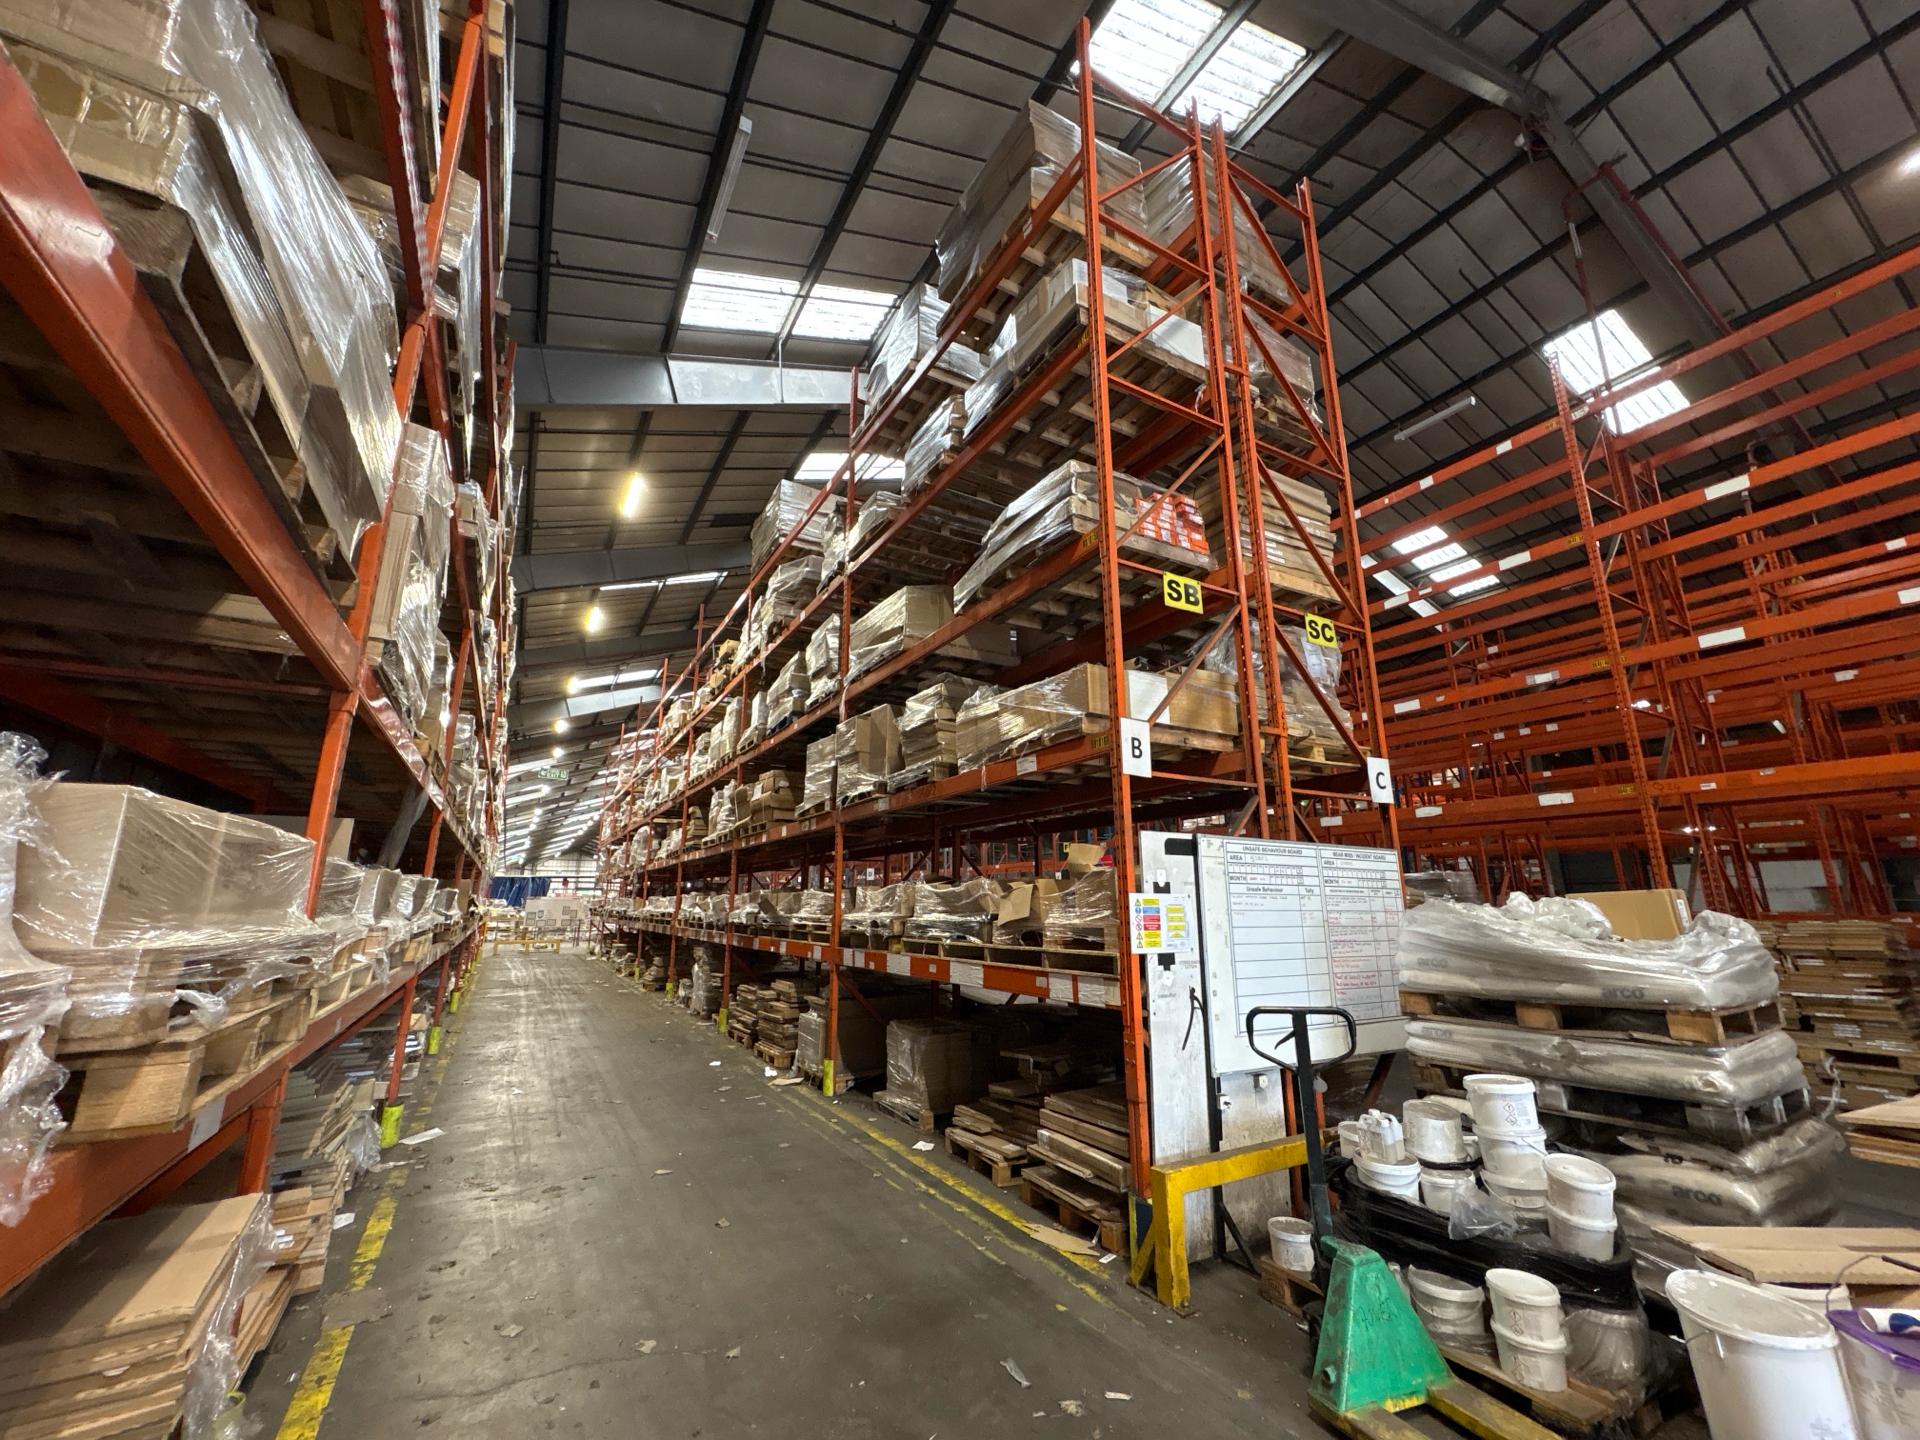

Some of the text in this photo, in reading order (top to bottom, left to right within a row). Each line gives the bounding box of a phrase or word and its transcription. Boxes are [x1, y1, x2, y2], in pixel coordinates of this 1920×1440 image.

[1167, 579, 1200, 607] SB
[1308, 619, 1335, 643] SC
[1131, 736, 1143, 759] B
[1375, 771, 1387, 790] C
[1229, 854, 1243, 862] AREA
